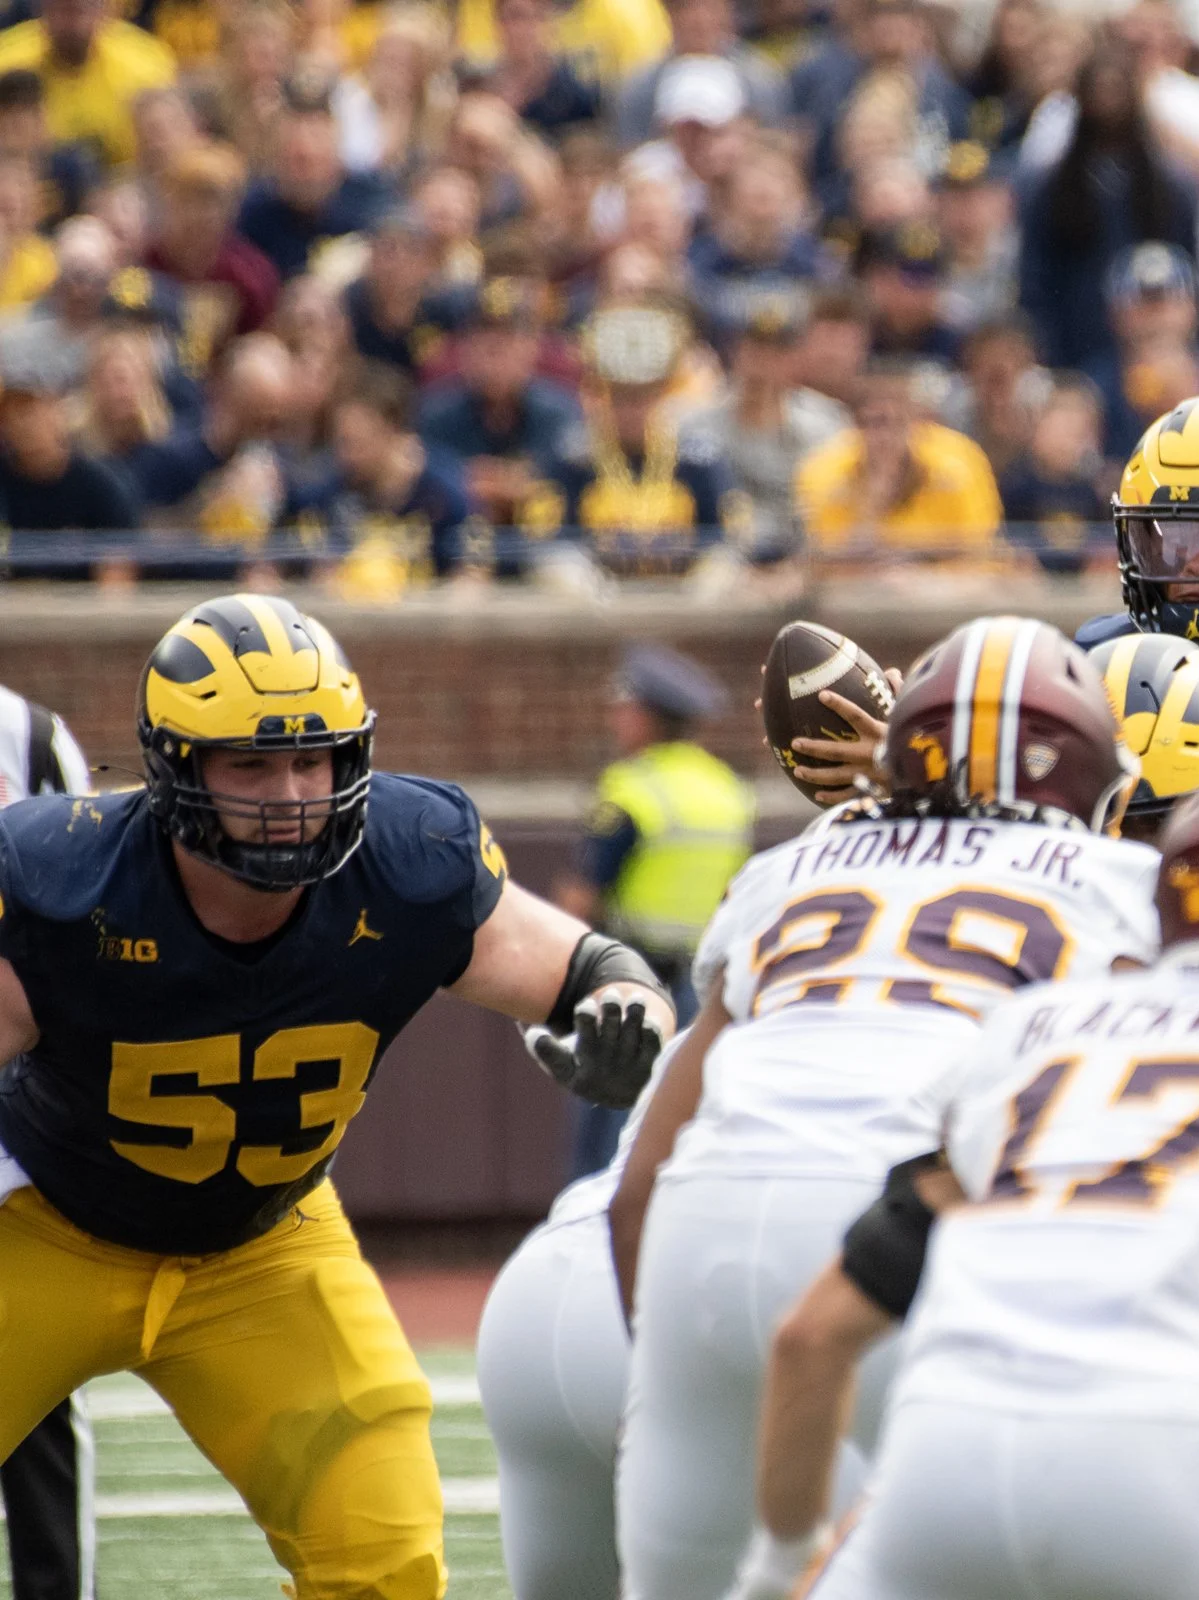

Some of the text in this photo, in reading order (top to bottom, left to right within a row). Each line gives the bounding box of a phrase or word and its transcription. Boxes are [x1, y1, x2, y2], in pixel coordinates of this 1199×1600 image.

[1170, 486, 1190, 501] M
[284, 716, 305, 735] M
[788, 817, 1083, 889] THOMAS JR.
[751, 883, 1078, 1020] 29
[108, 1021, 380, 1187] 53
